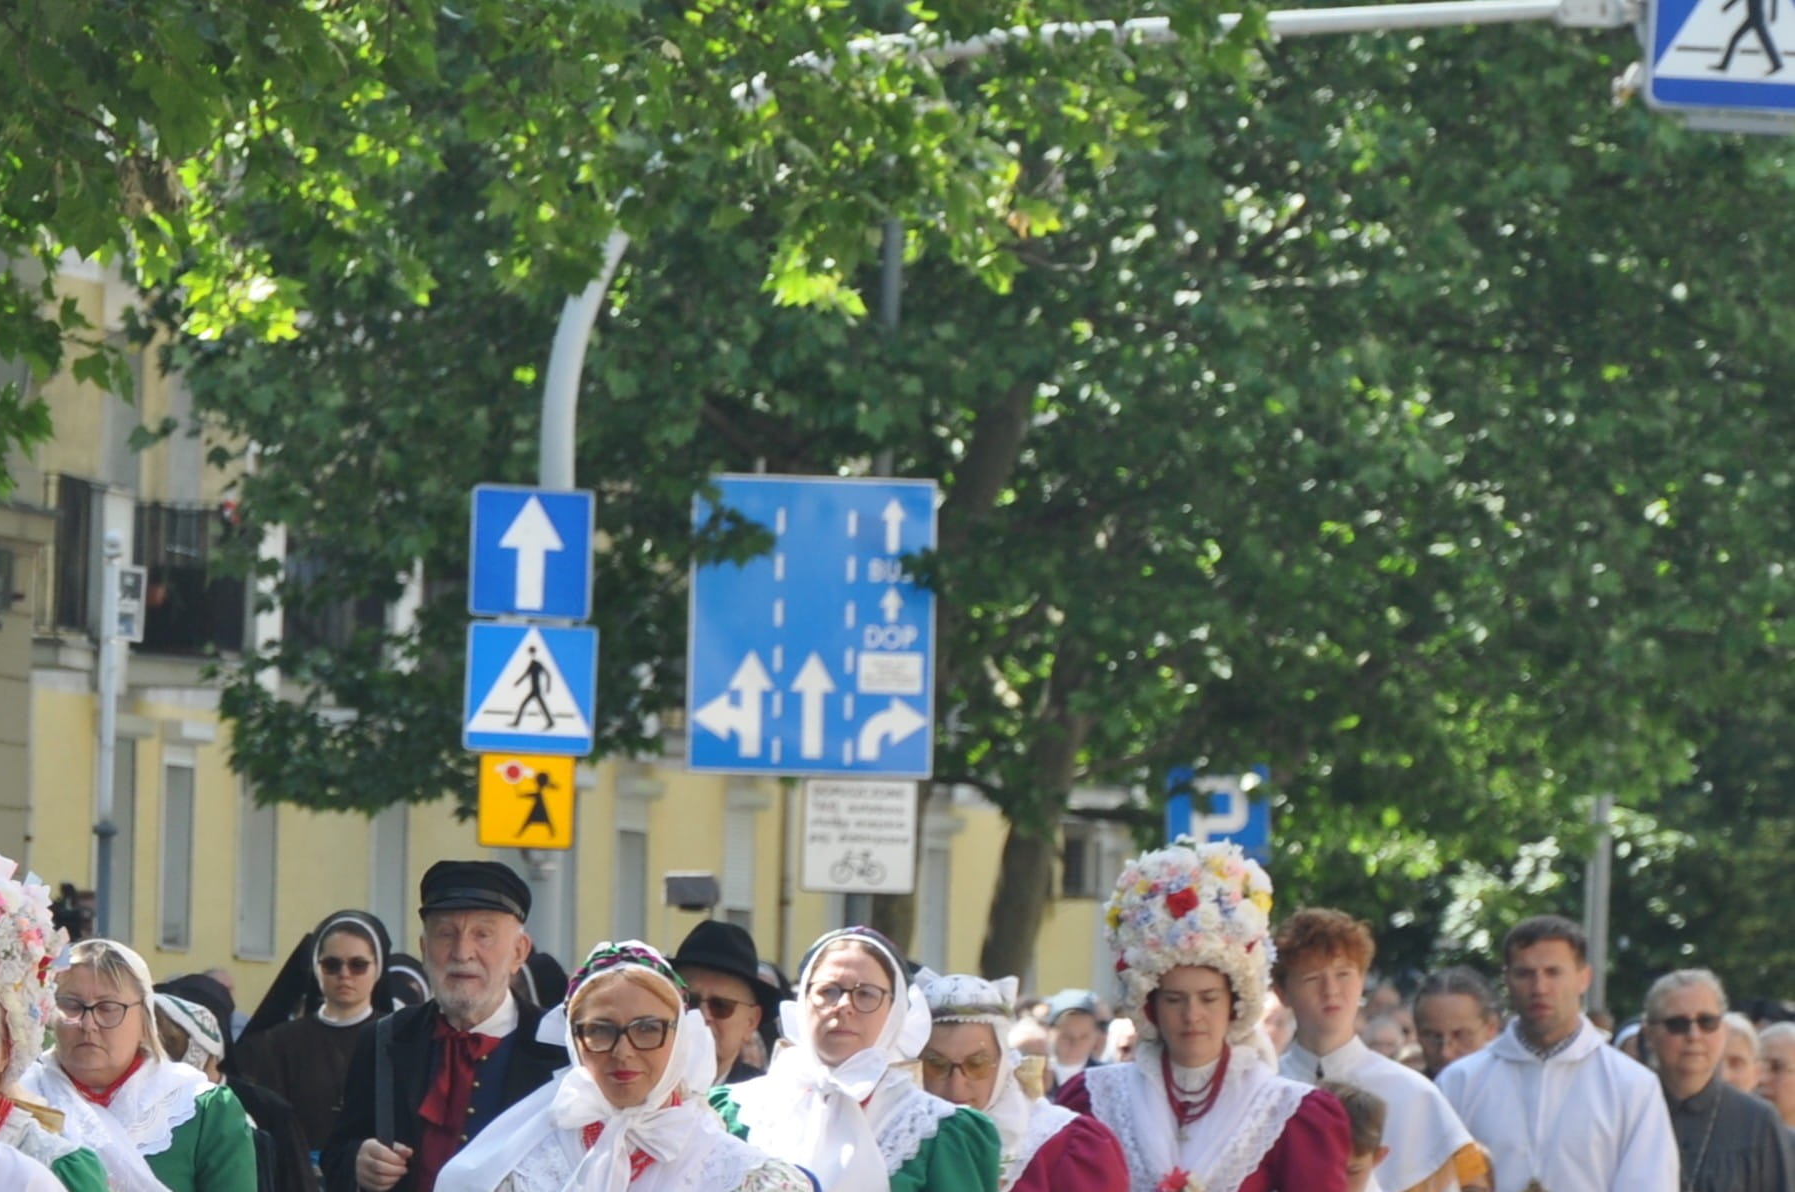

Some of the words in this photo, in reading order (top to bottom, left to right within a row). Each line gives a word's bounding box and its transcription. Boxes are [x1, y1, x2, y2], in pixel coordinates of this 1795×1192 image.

[868, 557, 915, 584] BU
[864, 624, 918, 650] DOP
[1190, 775, 1250, 845] P
